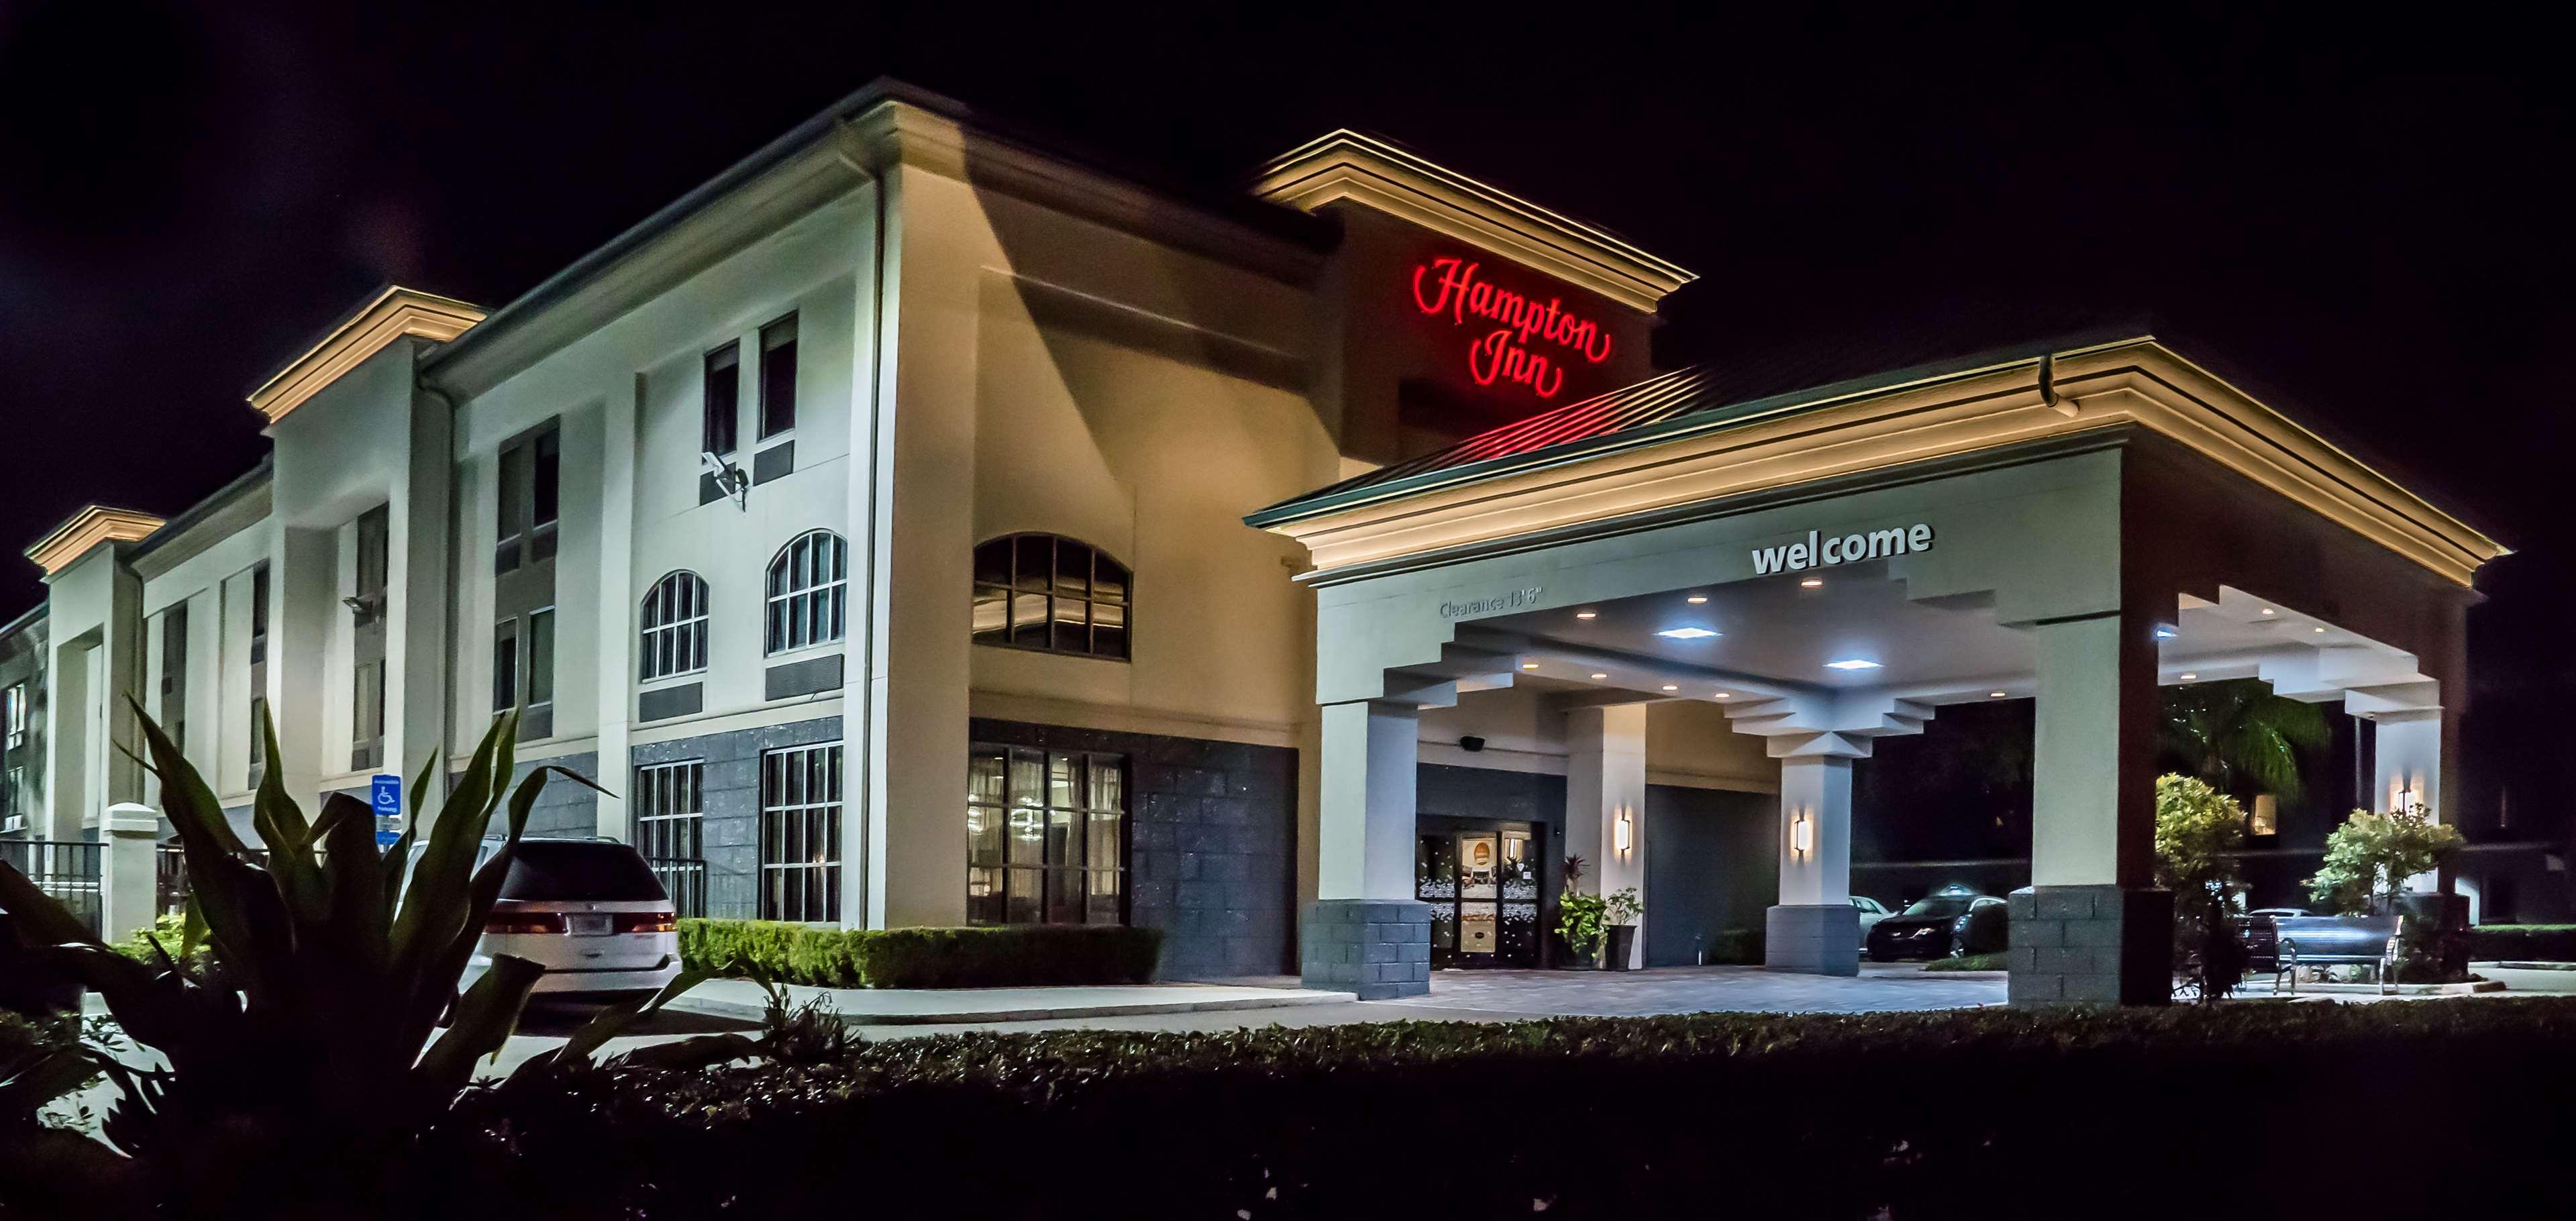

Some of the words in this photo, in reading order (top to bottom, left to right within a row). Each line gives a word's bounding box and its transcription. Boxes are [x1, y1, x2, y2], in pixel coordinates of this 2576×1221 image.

[1414, 258, 1610, 362] Hampton
[1470, 331, 1562, 396] Inn
[1752, 523, 1933, 574] welcome
[1439, 598, 1504, 619] Clearance
